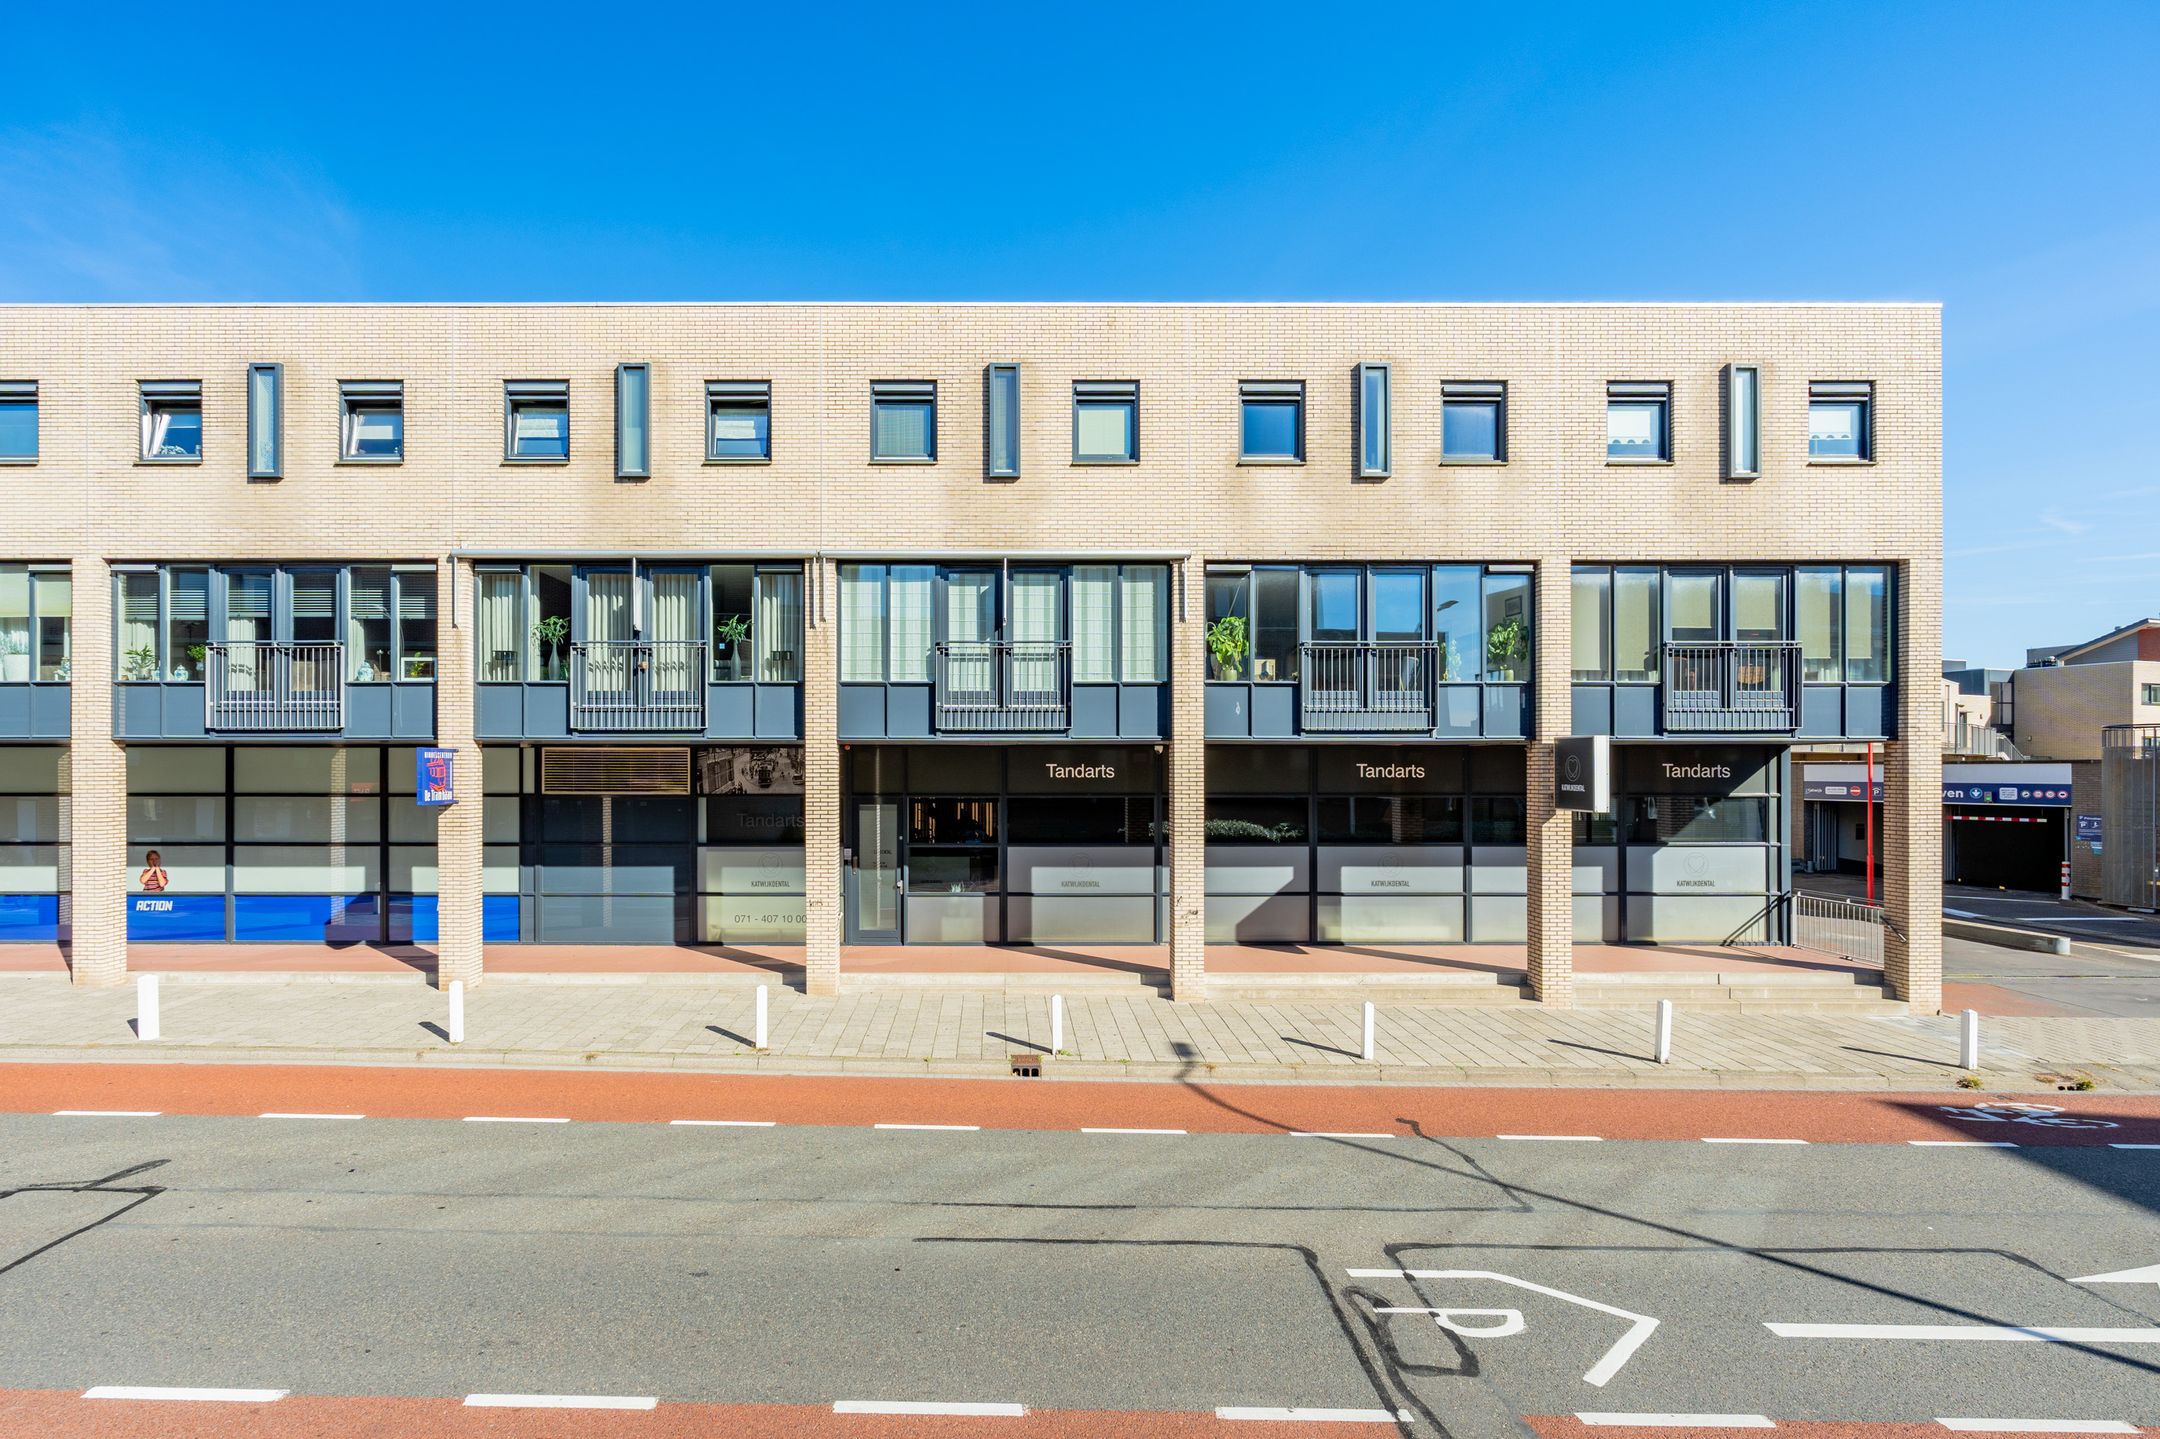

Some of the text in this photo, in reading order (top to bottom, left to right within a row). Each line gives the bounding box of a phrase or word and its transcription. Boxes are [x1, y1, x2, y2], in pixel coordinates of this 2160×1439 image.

[1045, 763, 1115, 778] Tandarts
[1356, 763, 1425, 778] Tandarts
[1662, 763, 1731, 778] Tandarts
[737, 813, 805, 828] Tandarts
[751, 880, 790, 888] KATWIJKDENTAL
[136, 900, 173, 911] ACTION
[734, 914, 751, 923] 071
[760, 914, 778, 923] 407
[782, 914, 793, 923] 10
[795, 914, 807, 923] 00
[1373, 1308, 1524, 1338] P
